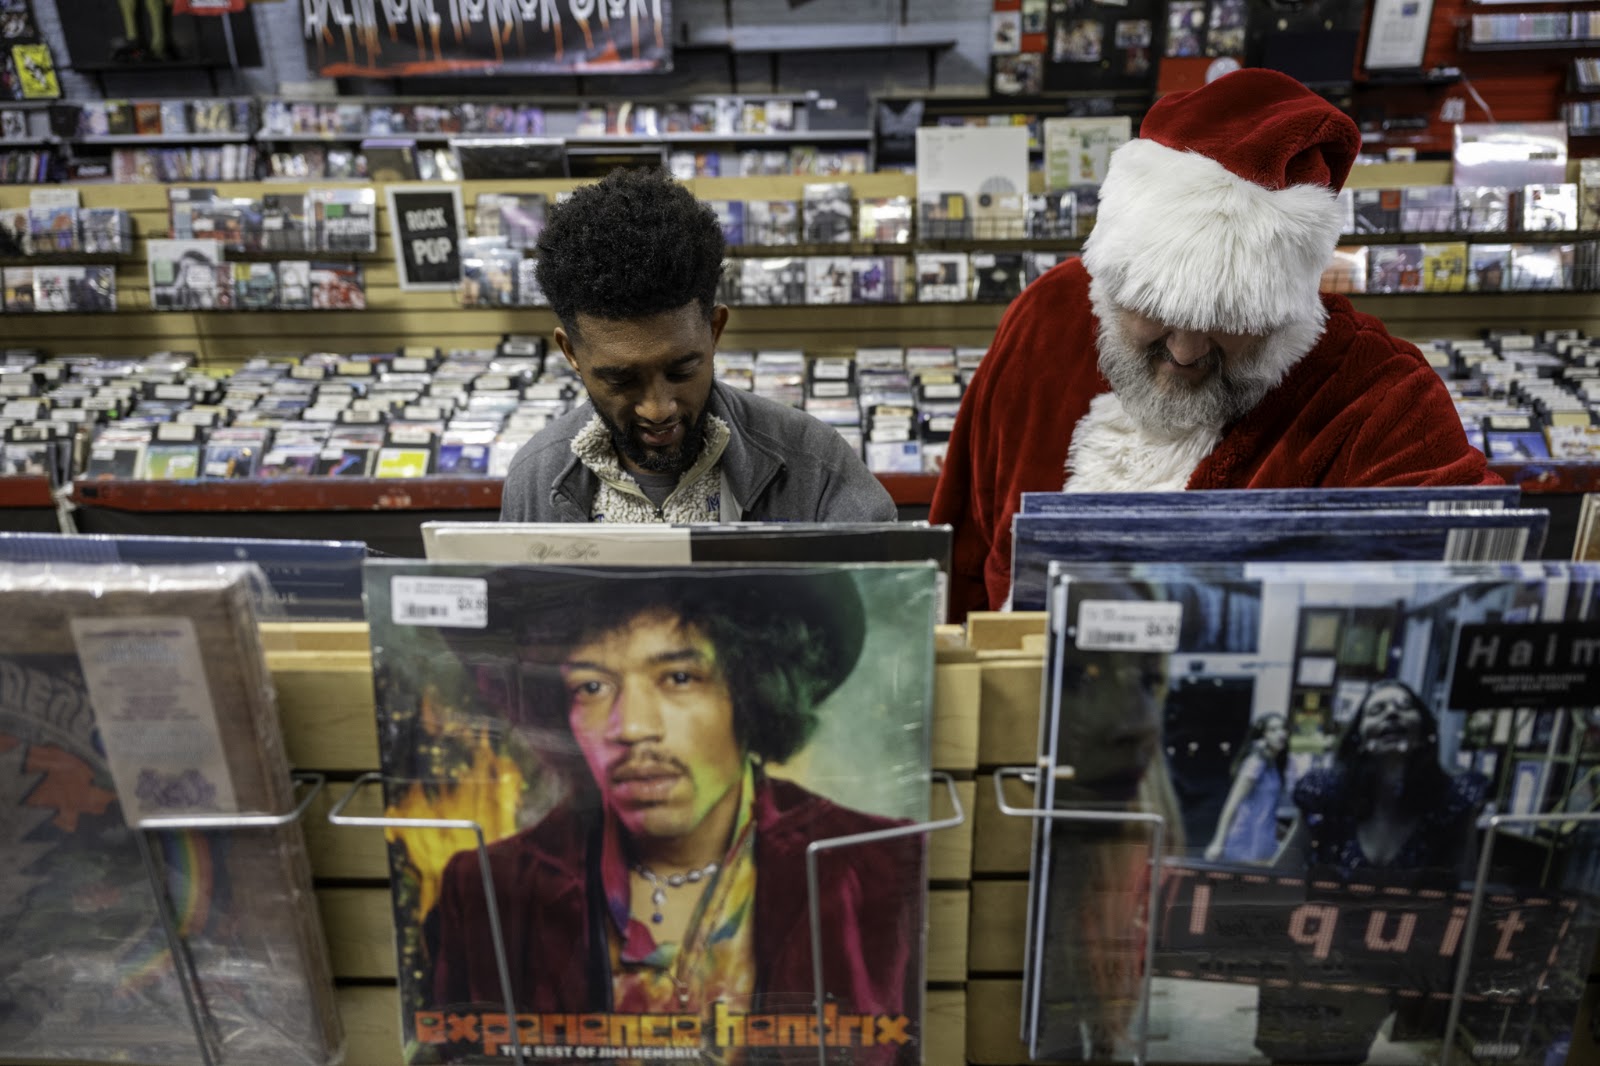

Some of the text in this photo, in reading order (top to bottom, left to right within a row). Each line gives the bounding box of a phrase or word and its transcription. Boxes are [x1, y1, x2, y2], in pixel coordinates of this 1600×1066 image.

[405, 207, 447, 232] ROCK
[411, 236, 452, 265] POP
[1189, 884, 1525, 960] I quit
[415, 1002, 909, 1056] experience hendrix
[574, 1046, 597, 1058] OF
[631, 1047, 700, 1059] HENDRIX
